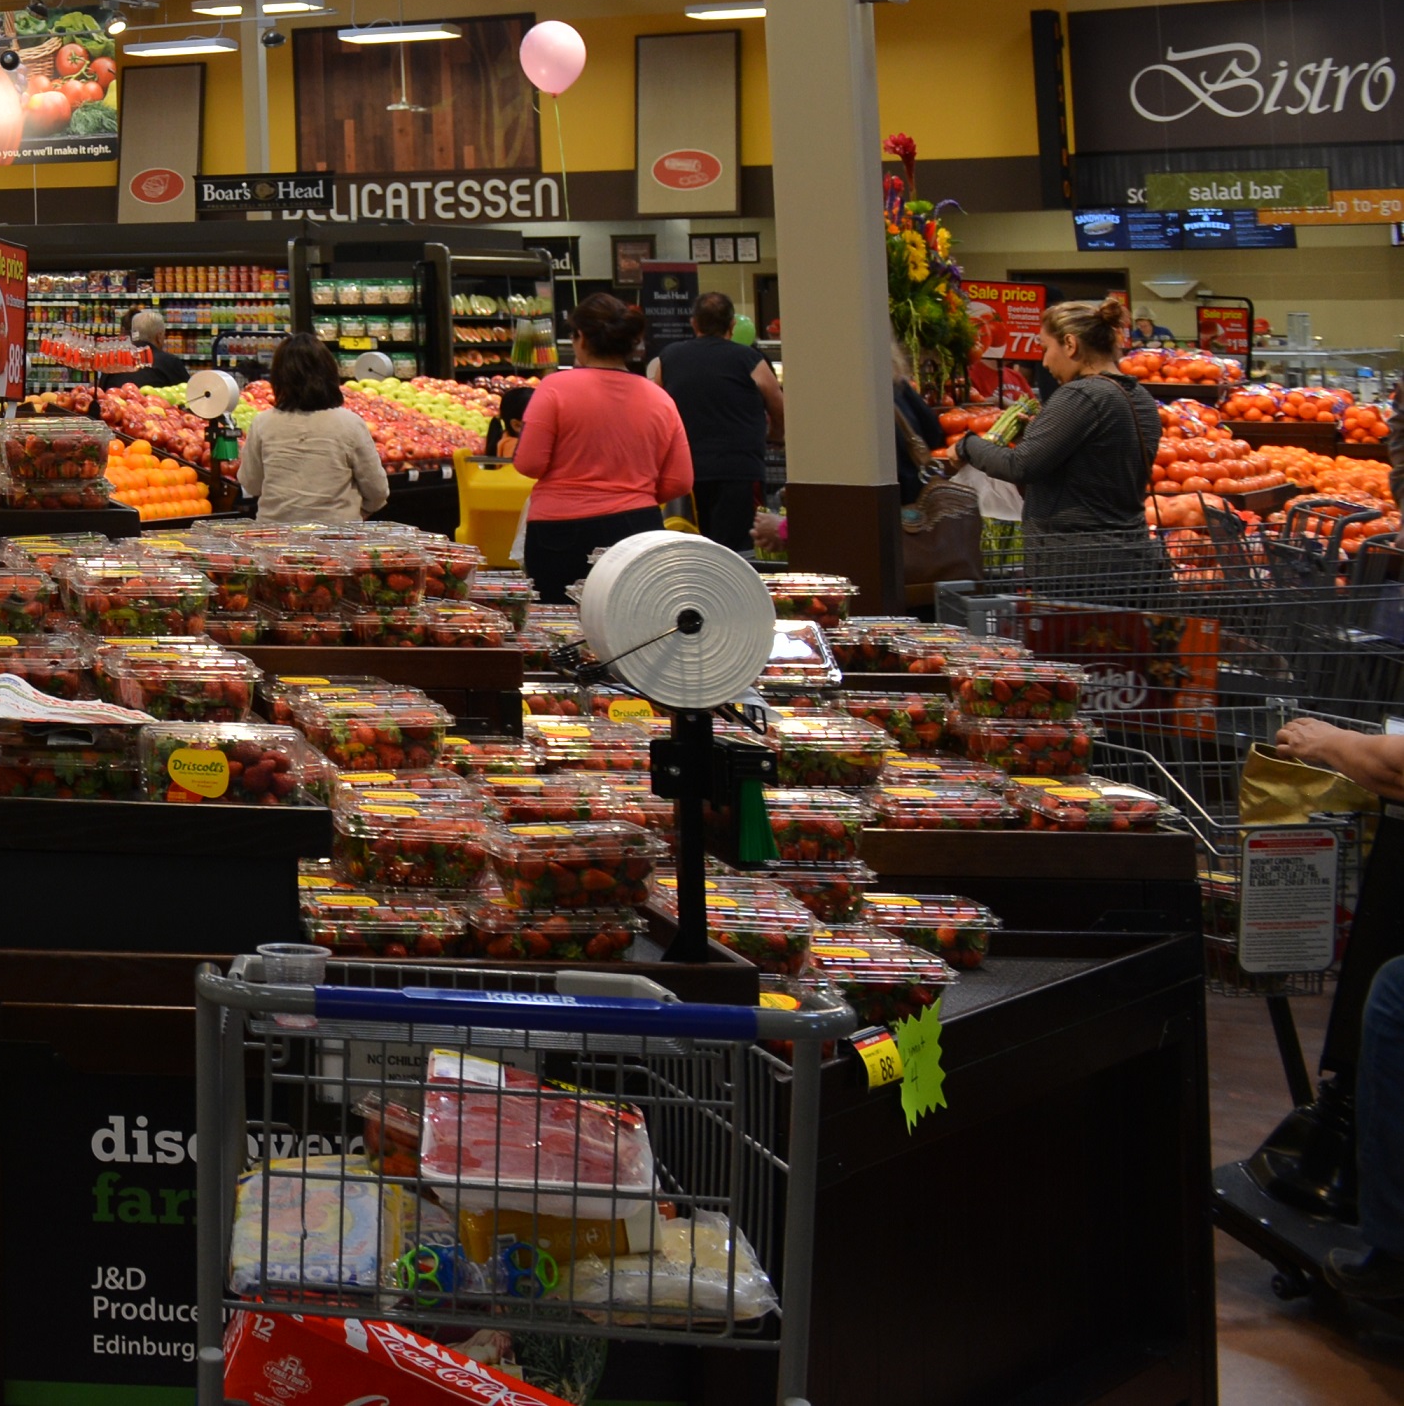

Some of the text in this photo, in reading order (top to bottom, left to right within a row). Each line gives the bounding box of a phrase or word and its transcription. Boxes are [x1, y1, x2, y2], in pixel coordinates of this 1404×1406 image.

[1130, 42, 1397, 122] Bistro
[2, 150, 21, 160] you,
[22, 149, 32, 157] or
[54, 145, 78, 155] make
[79, 145, 86, 154] it
[86, 144, 112, 156] right.
[201, 179, 324, 202] Boar's Head
[1189, 180, 1284, 202] salad bar
[1352, 197, 1402, 216] to-go
[6, 253, 24, 284] price
[968, 285, 1037, 303] Sale price
[1007, 313, 1041, 322] Tomatoes
[1202, 309, 1243, 321] Sale price
[172, 759, 225, 773] Driscoll's
[486, 992, 577, 1005] KROGER
[91, 1265, 146, 1291] J&D
[254, 1313, 276, 1337] 12
[252, 1329, 270, 1343] cans
[381, 1335, 507, 1399] Coca-Cola
